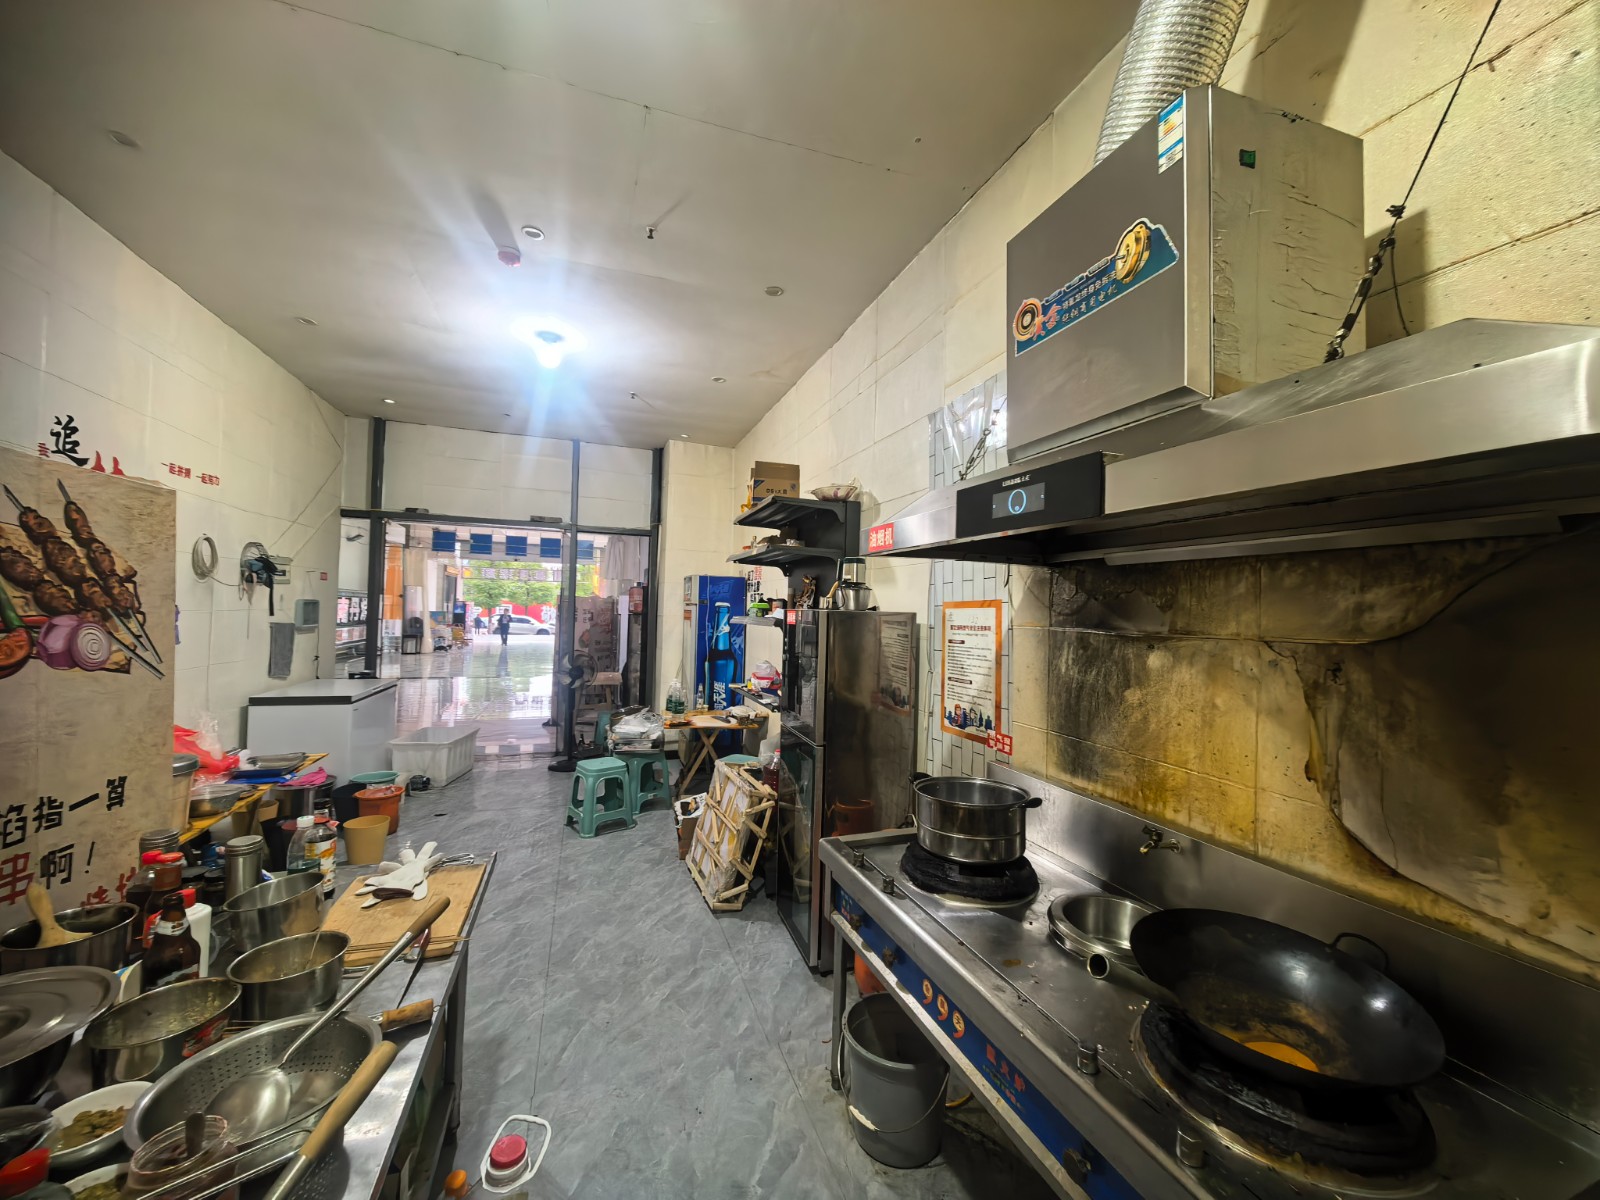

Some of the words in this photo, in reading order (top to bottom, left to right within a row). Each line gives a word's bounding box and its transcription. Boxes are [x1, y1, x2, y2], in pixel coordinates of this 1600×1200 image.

[50, 414, 90, 467] 追
[869, 527, 893, 547] 油烟机
[922, 978, 966, 1039] 999
